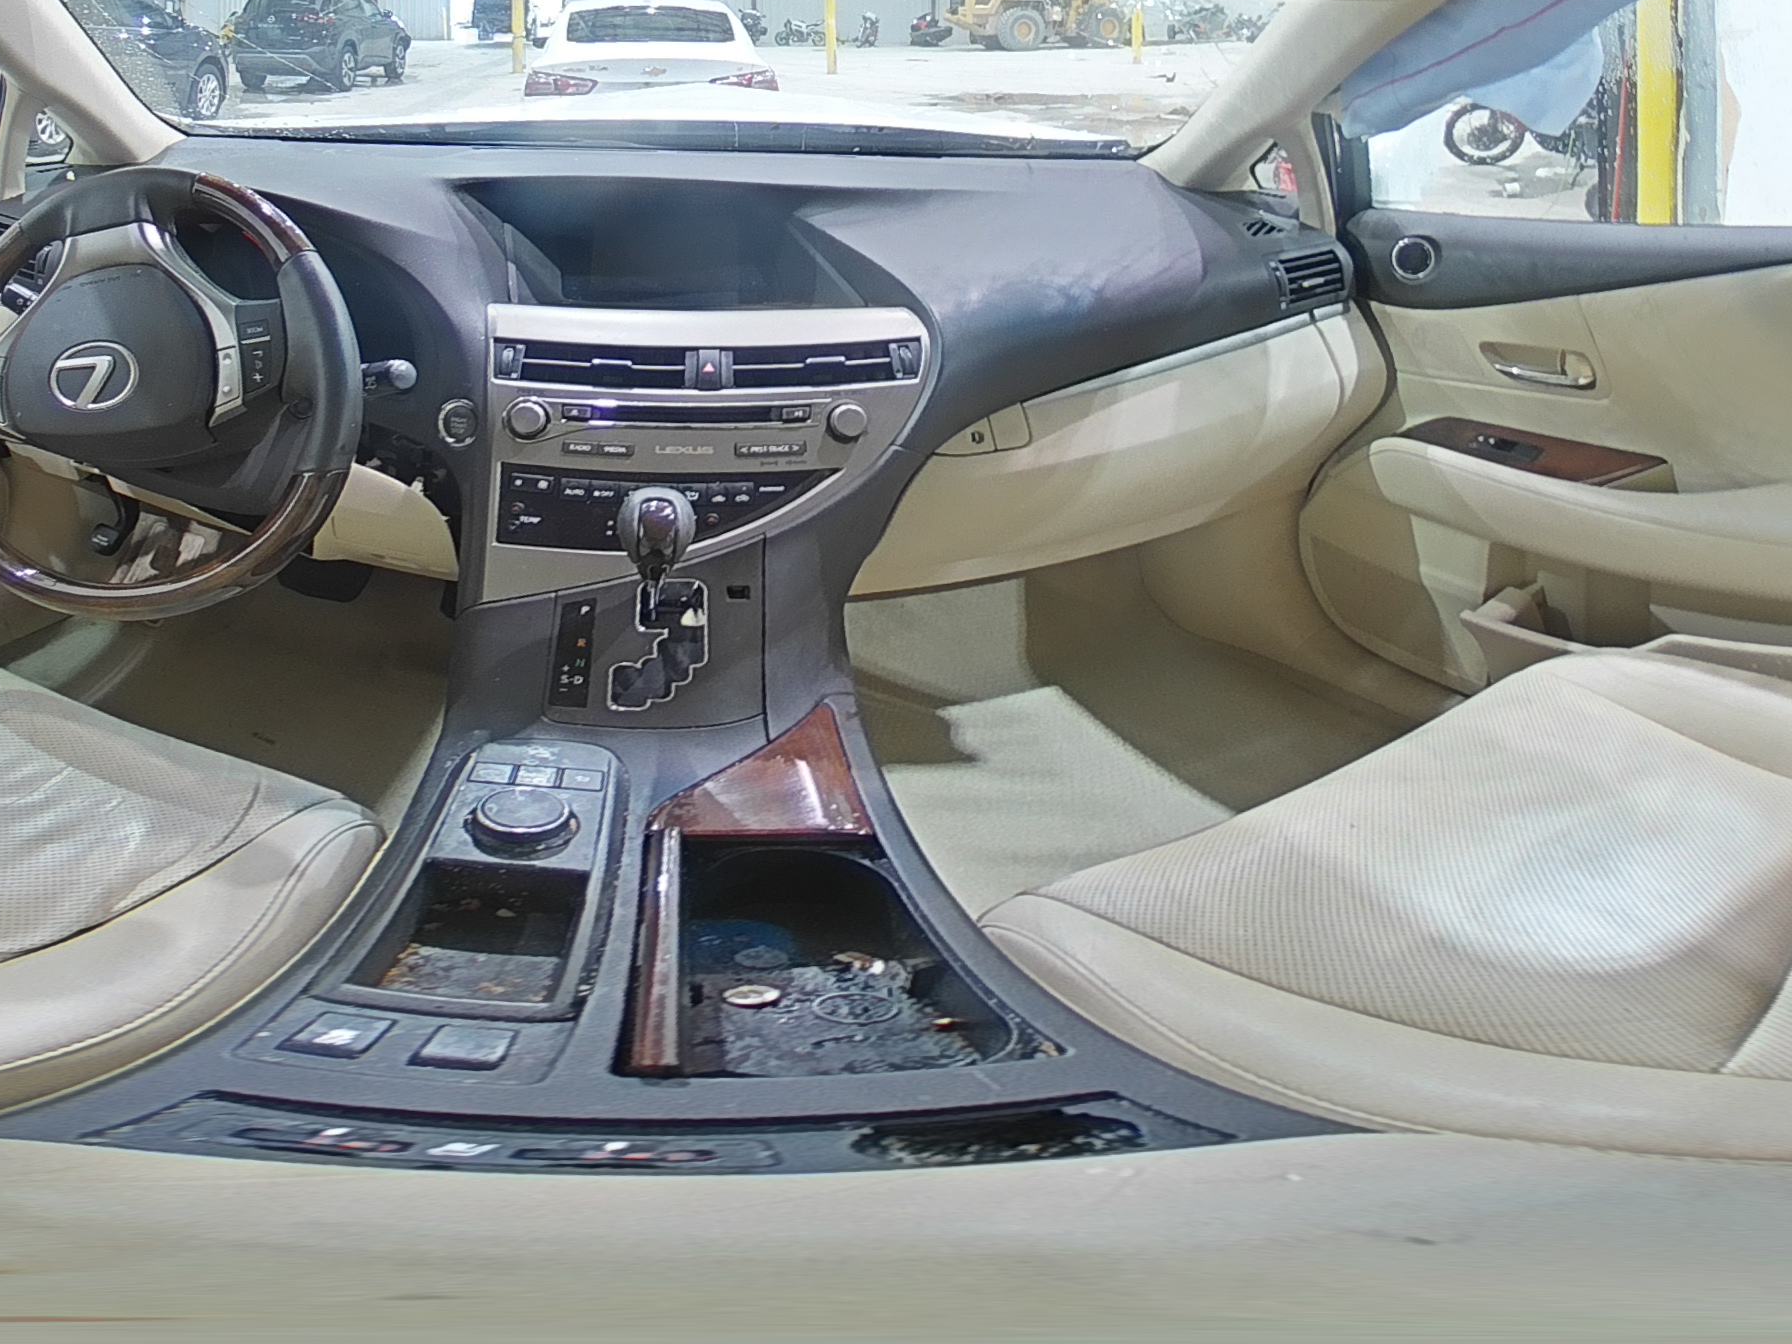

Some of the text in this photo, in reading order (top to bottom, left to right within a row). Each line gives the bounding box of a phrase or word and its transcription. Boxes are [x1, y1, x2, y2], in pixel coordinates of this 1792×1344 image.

[655, 445, 714, 455] LEXUS
[564, 488, 585, 496] AUTO
[580, 605, 590, 615] P
[577, 638, 587, 648] R
